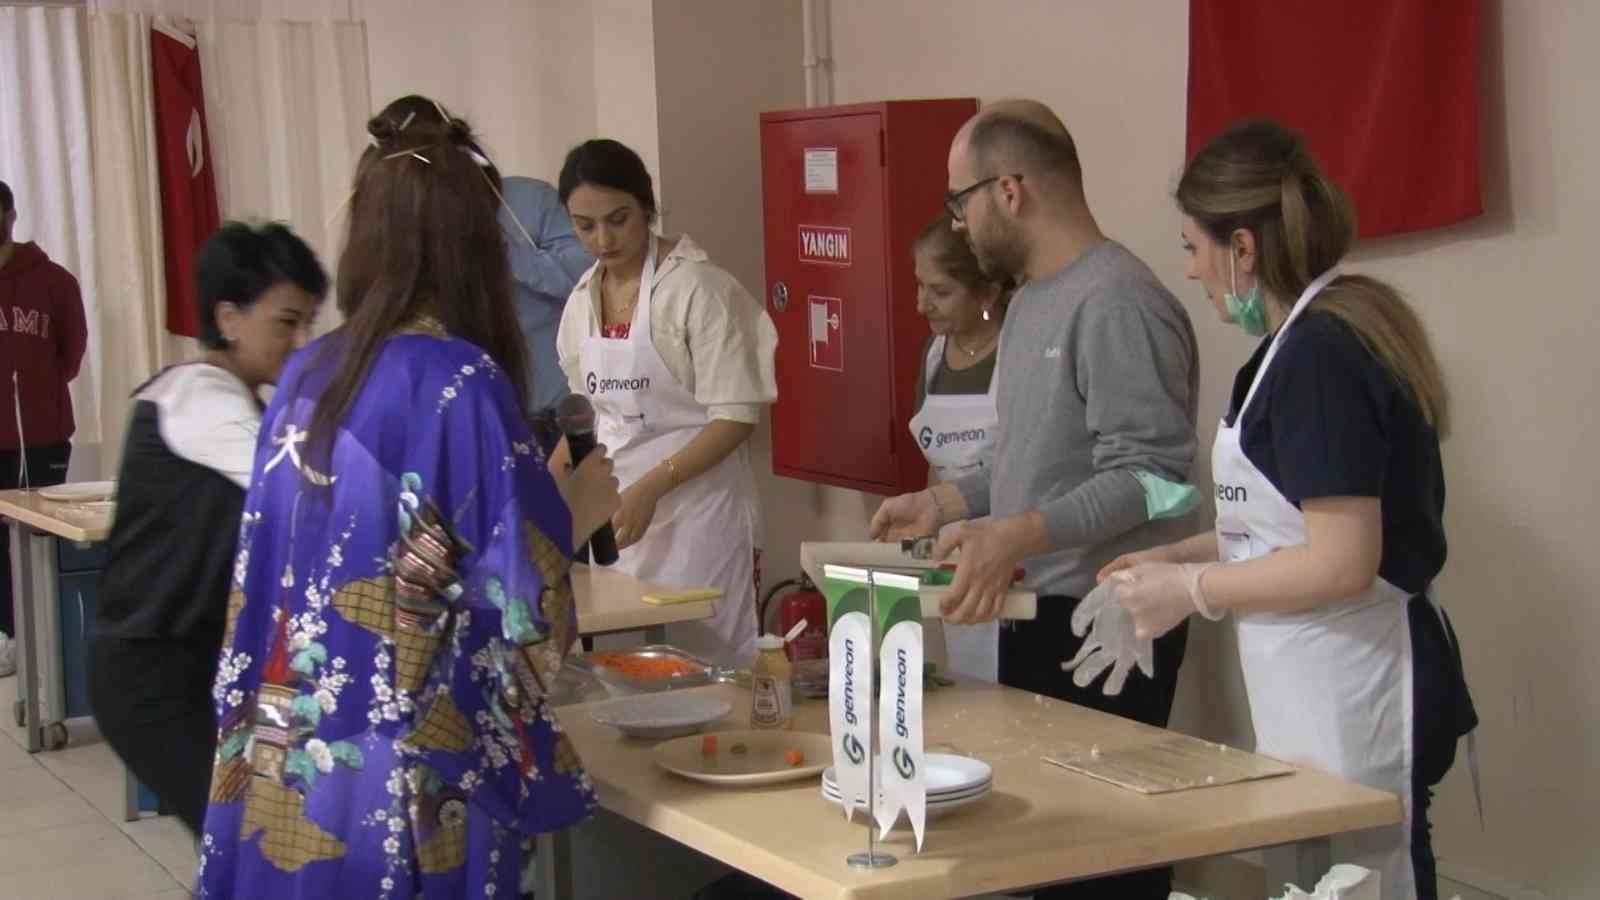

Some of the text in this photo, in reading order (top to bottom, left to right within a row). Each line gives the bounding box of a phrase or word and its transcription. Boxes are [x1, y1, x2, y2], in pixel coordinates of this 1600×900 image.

[801, 231, 848, 259] YANGIN
[844, 639, 858, 727] genveon
[895, 648, 909, 739] genveon
